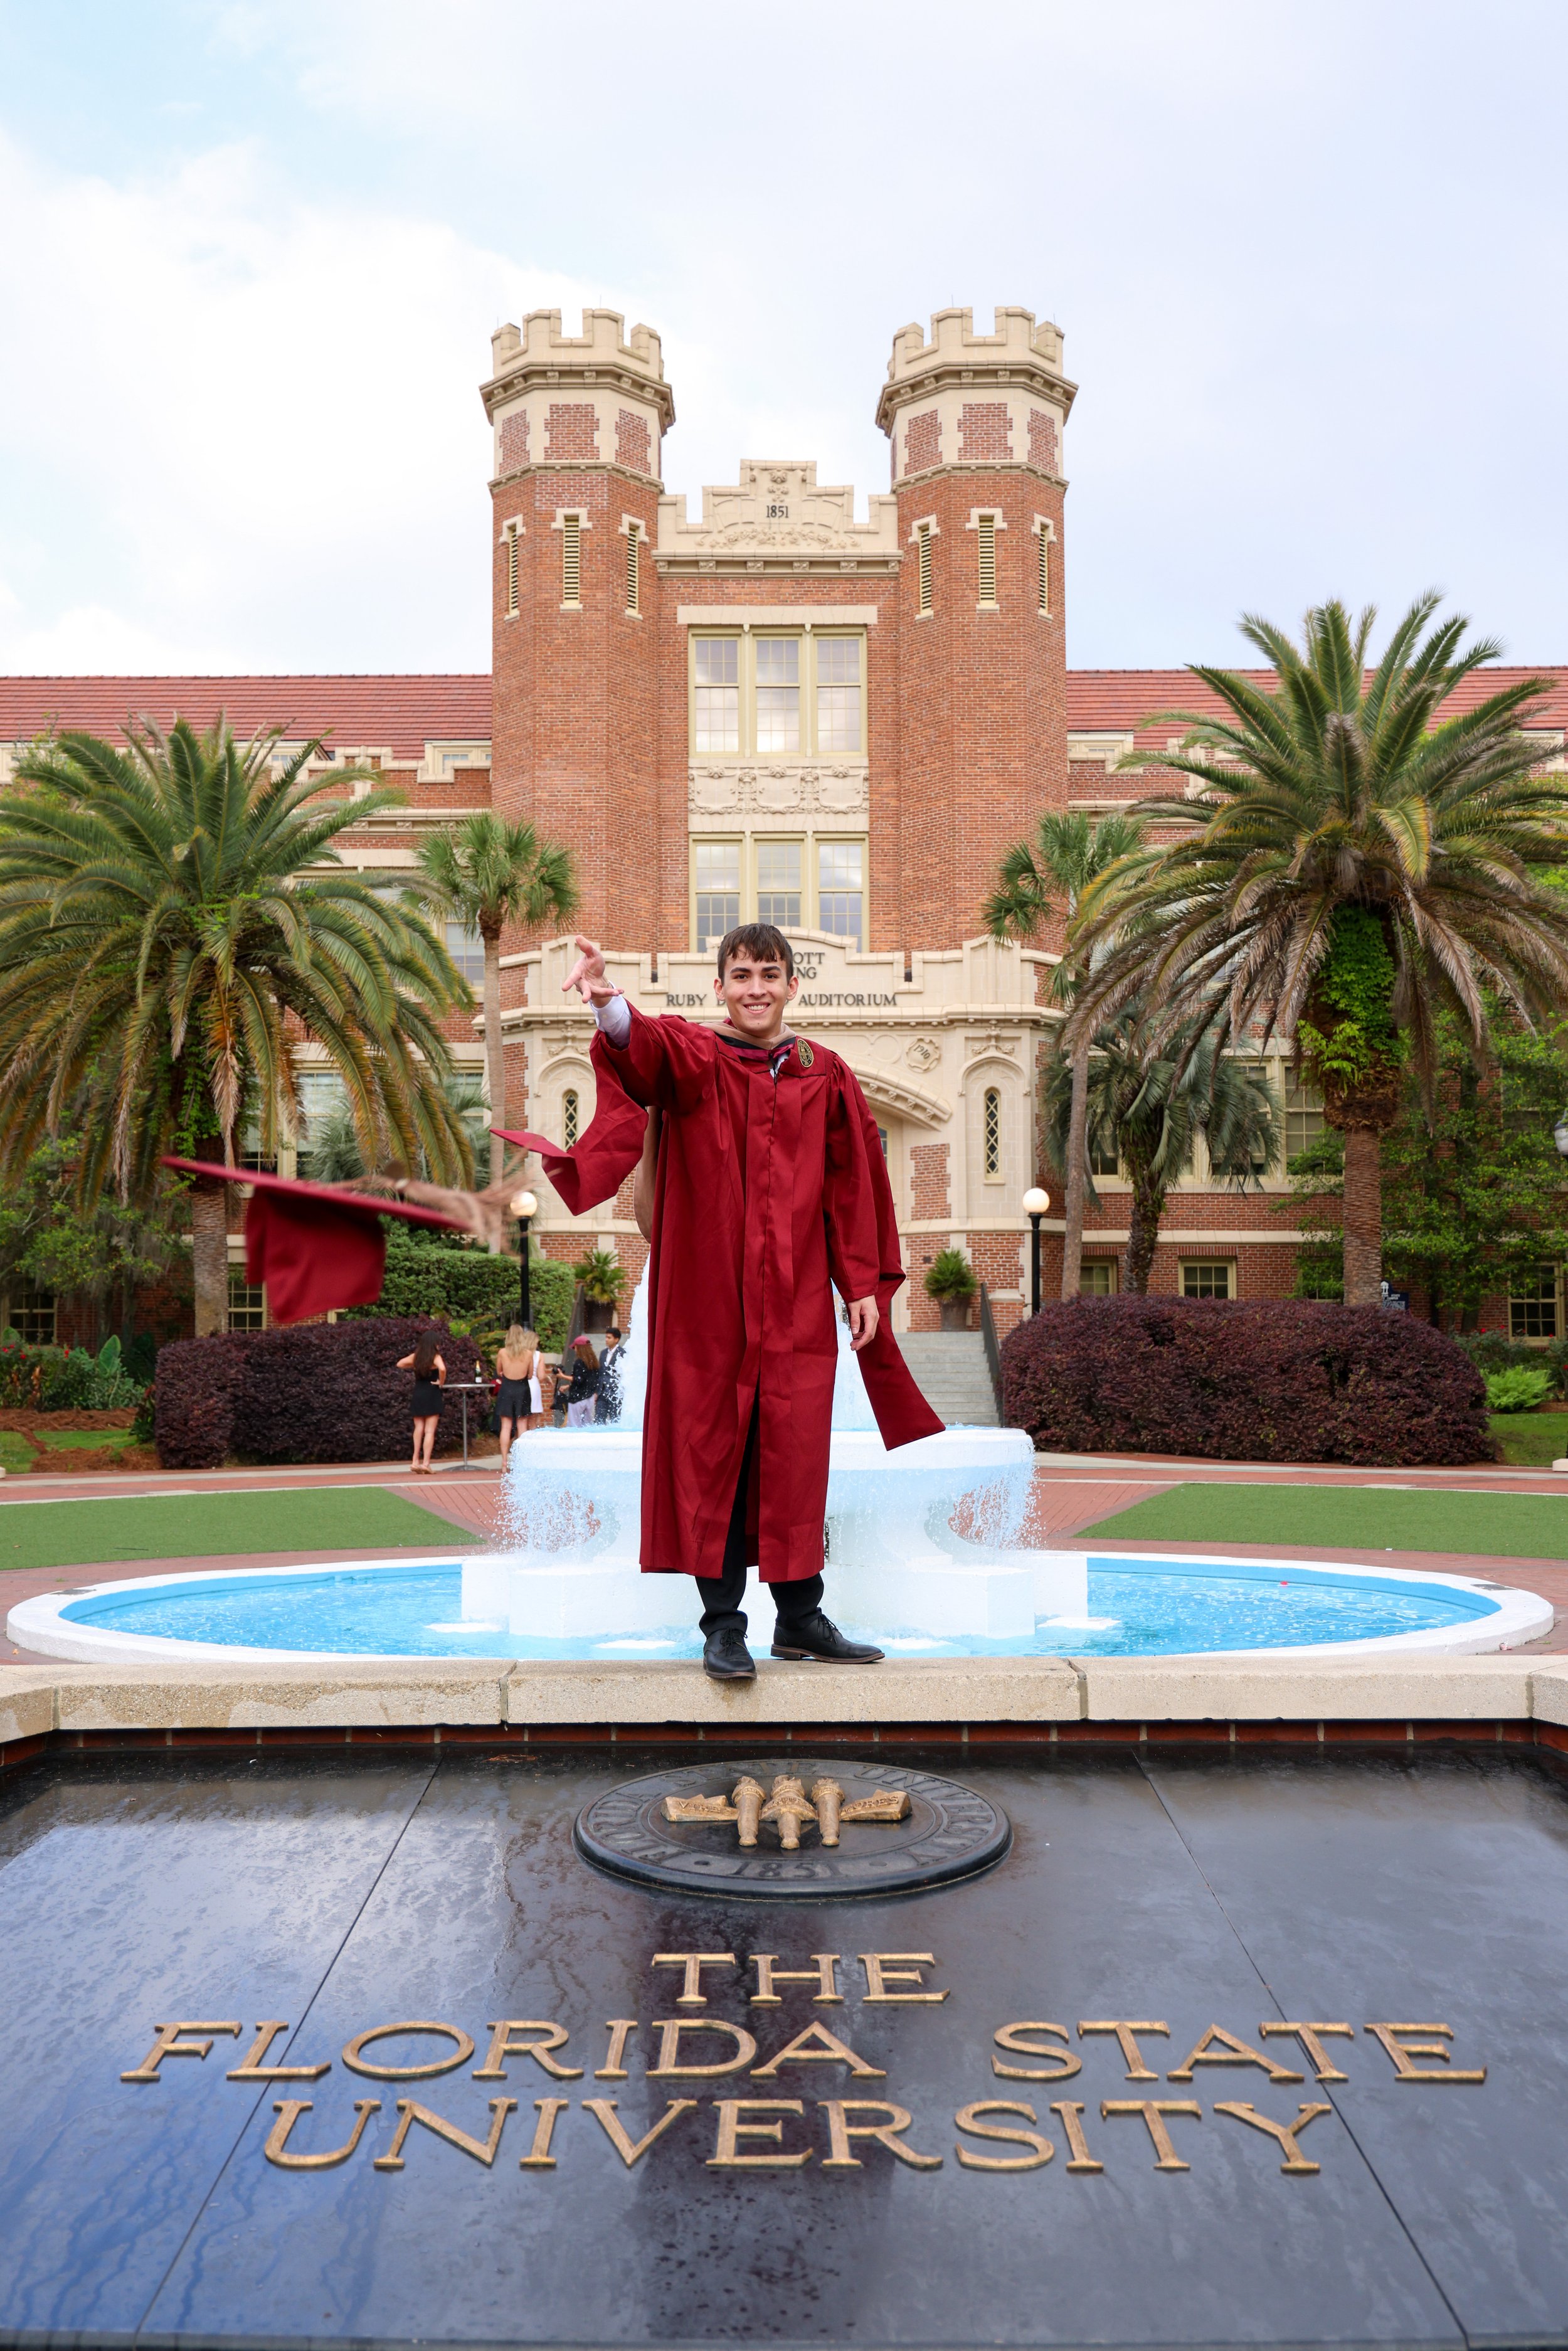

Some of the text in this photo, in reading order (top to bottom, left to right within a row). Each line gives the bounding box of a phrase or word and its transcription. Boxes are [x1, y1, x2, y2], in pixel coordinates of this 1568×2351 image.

[766, 505, 788, 518] 1851
[666, 994, 707, 1006] RUBY
[798, 994, 897, 1006] AUDITORIUM
[914, 1044, 931, 1059] 1910
[726, 1861, 847, 1878] 1851
[651, 1952, 950, 2004] THE
[119, 2019, 1487, 2083] FLORIDA STATE
[263, 2099, 1332, 2173] UNIVERSITY
